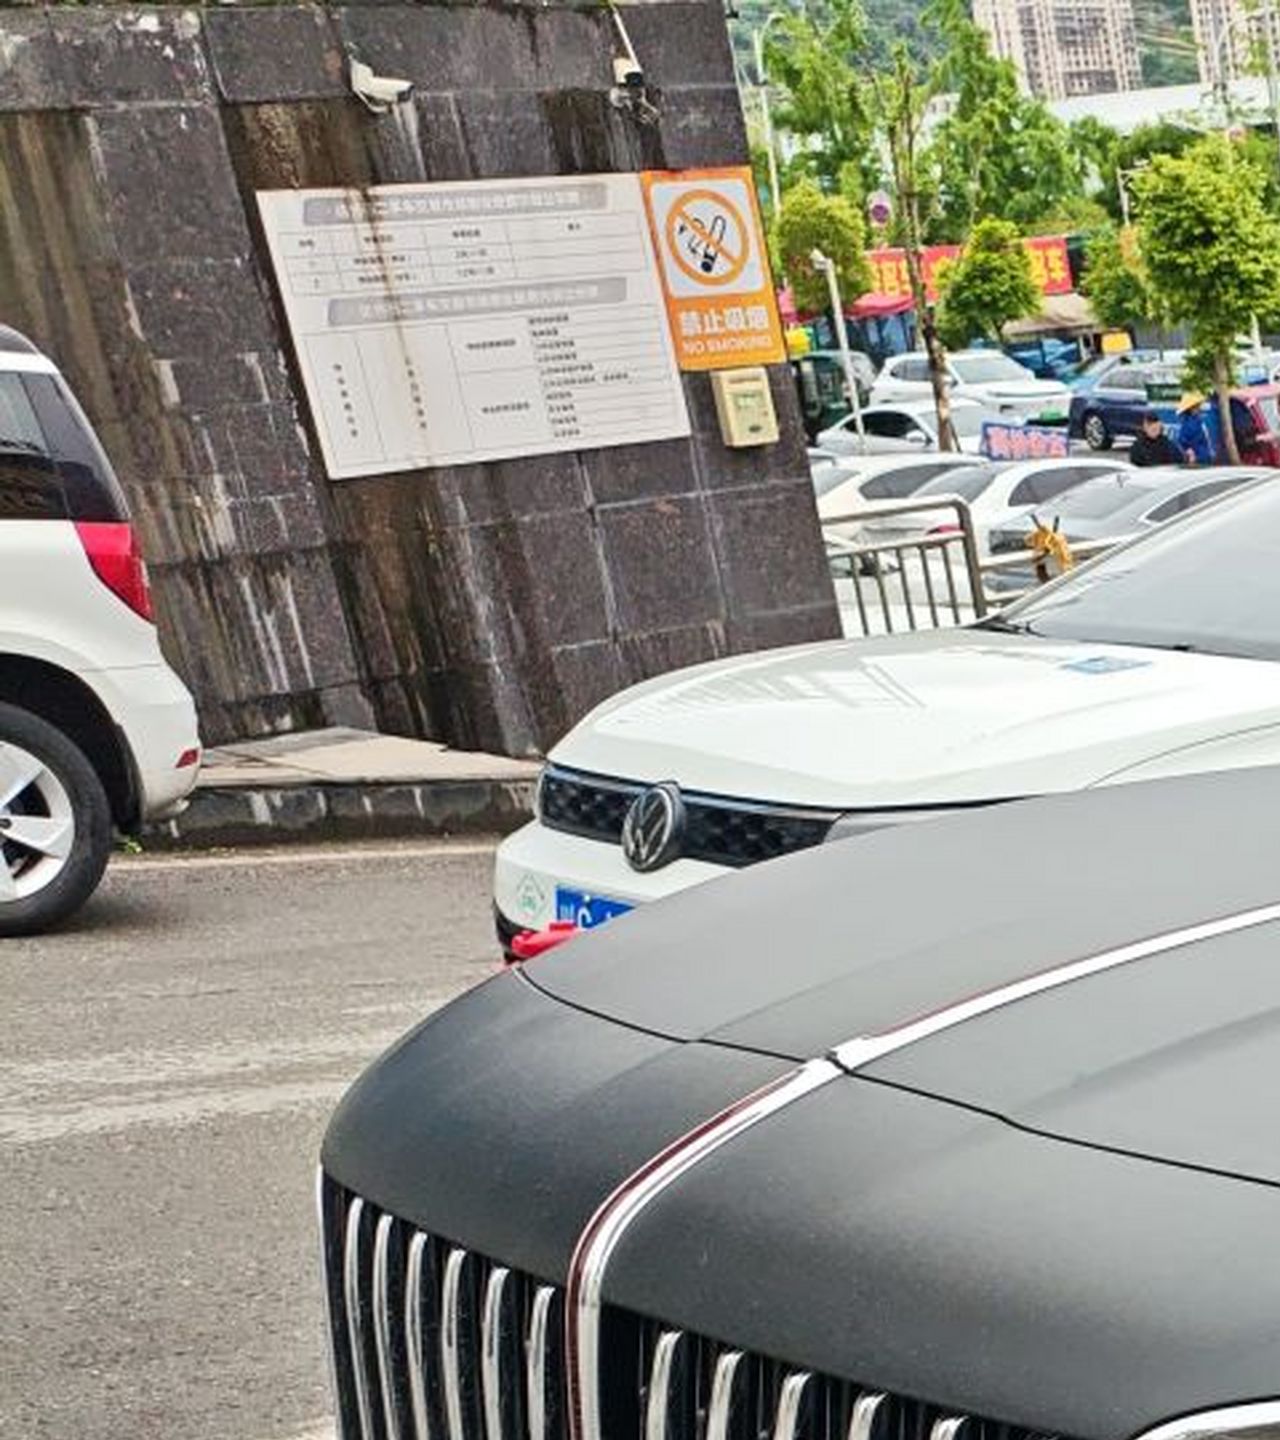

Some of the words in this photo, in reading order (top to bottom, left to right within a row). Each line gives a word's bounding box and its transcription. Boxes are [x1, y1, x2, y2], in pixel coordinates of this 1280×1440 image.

[680, 305, 769, 336] 禁止吸烟
[682, 339, 704, 354] NO
[707, 335, 773, 352] SMOKING
